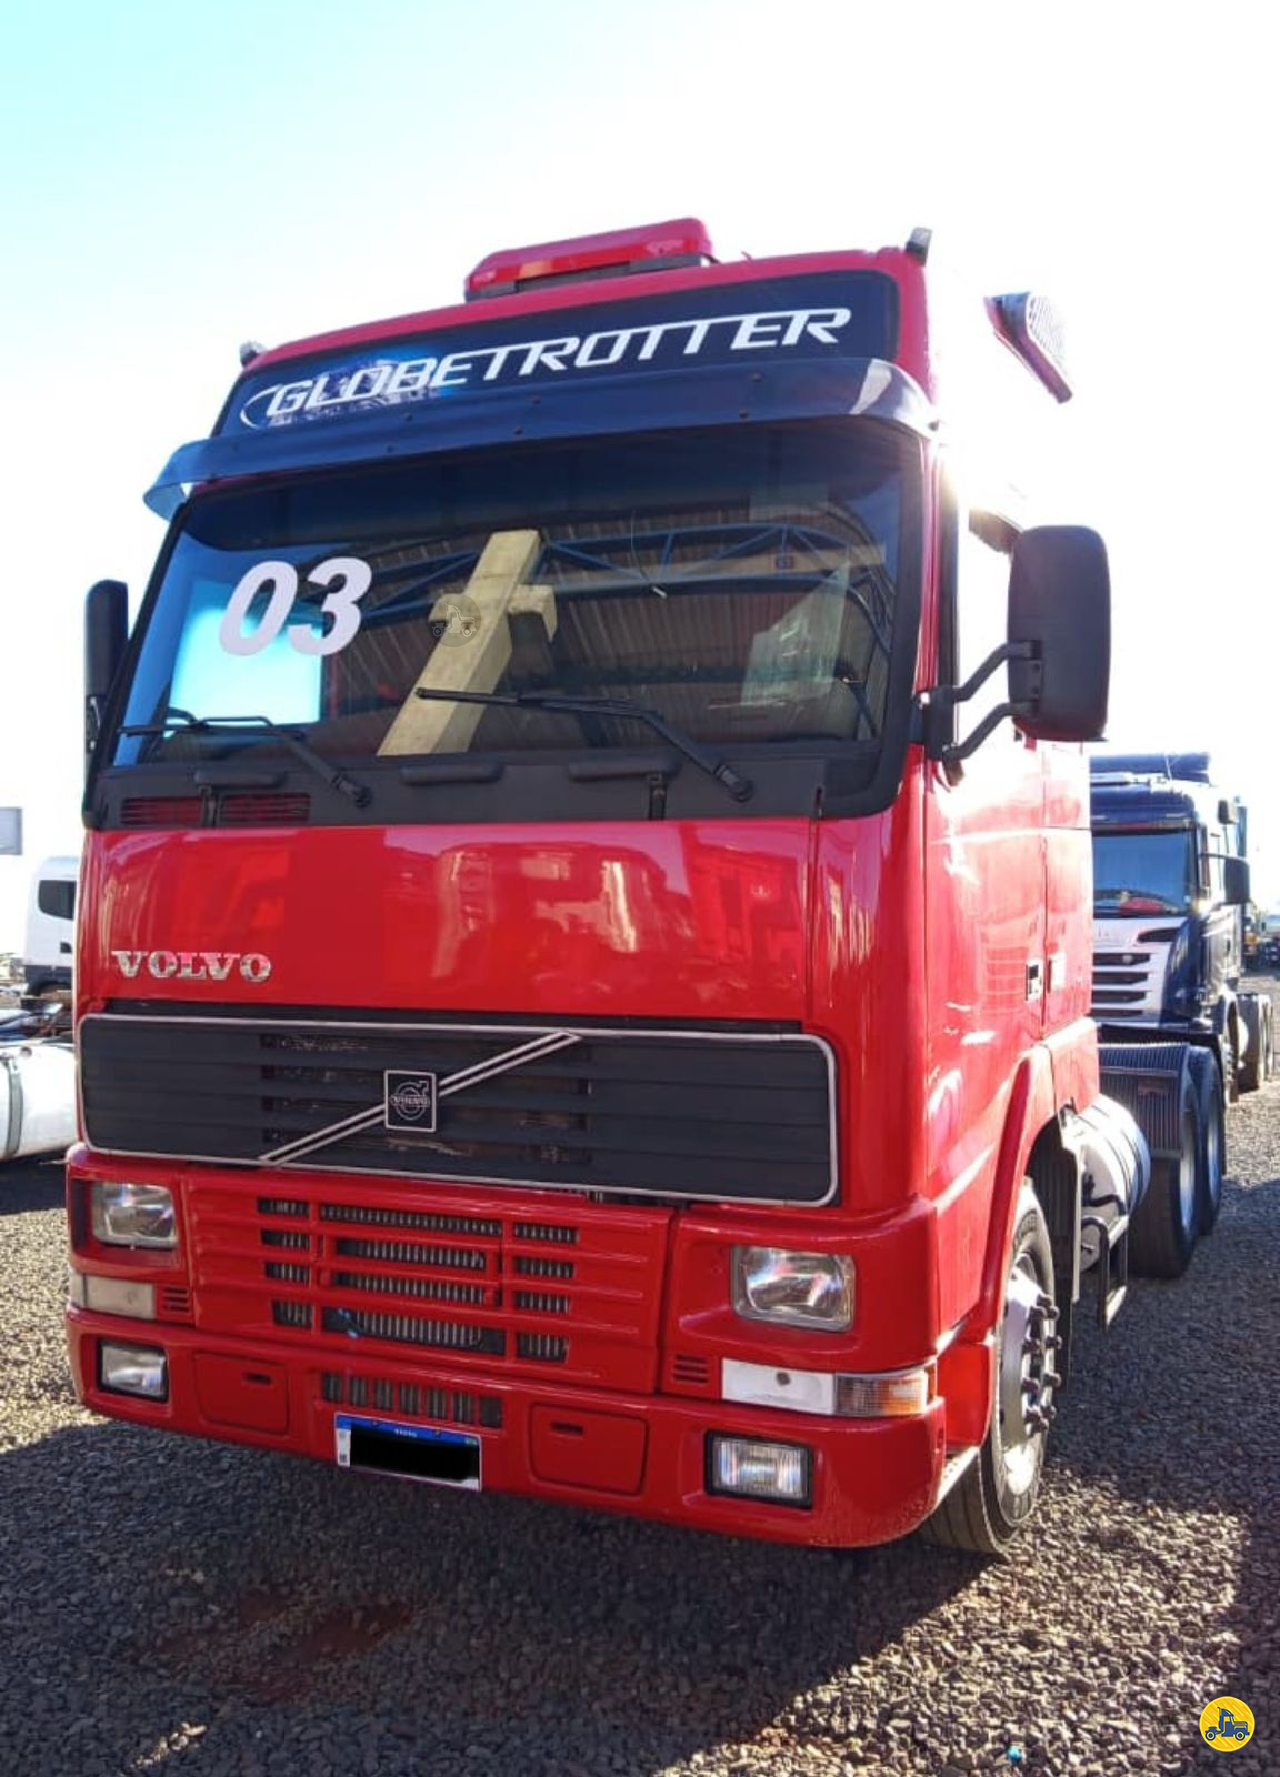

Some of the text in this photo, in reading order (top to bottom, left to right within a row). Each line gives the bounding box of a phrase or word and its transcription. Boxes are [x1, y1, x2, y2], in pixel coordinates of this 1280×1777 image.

[266, 307, 852, 416] GLOBETROTTER
[218, 557, 372, 656] 03
[111, 950, 272, 983] VOLVO
